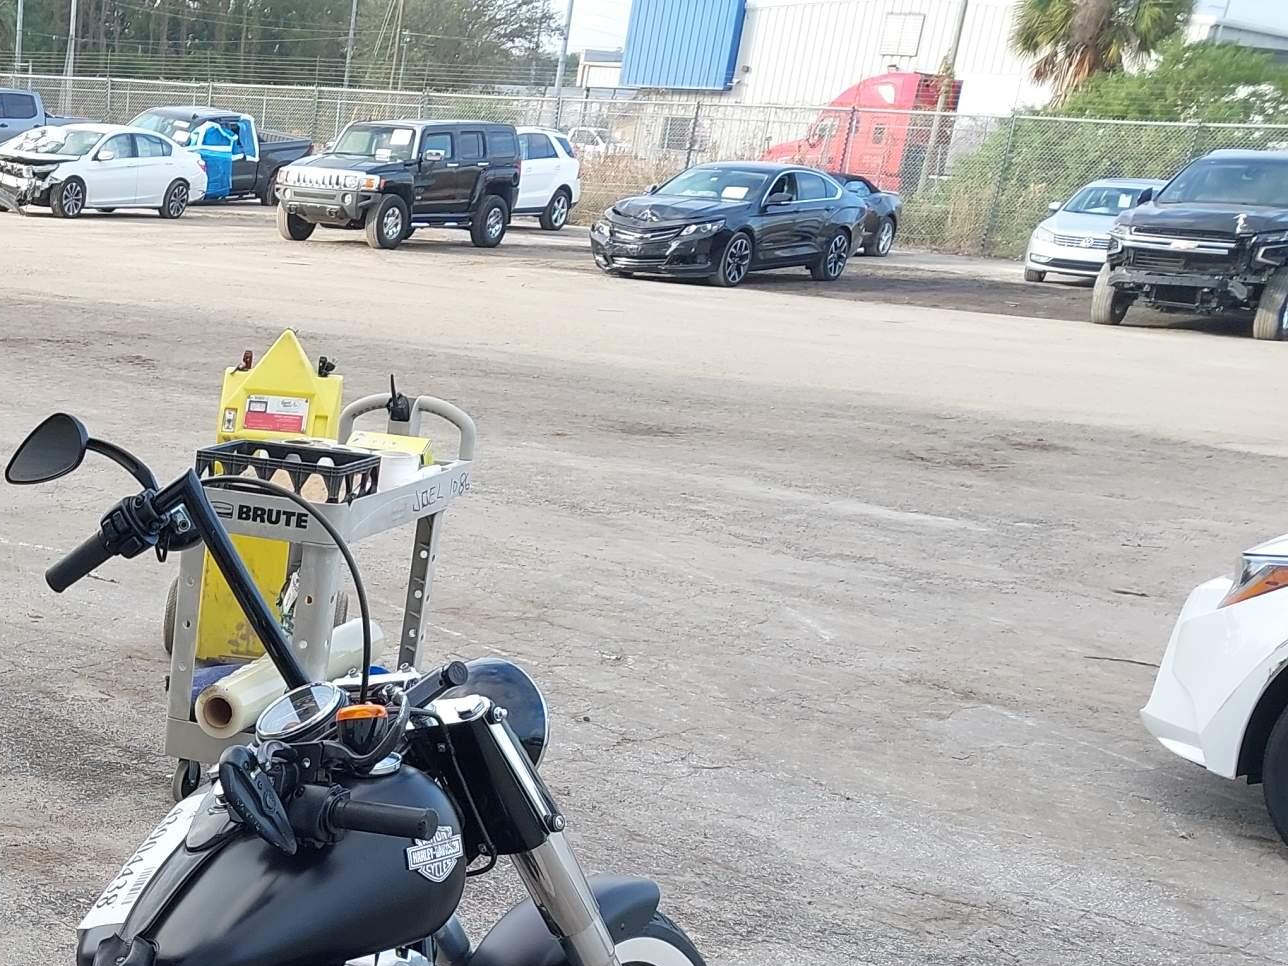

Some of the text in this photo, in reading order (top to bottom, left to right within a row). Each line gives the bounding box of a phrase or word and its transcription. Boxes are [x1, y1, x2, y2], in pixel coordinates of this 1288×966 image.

[413, 482, 444, 512] JOEL
[237, 503, 309, 529] BRUTE
[426, 858, 452, 877] CYCLES
